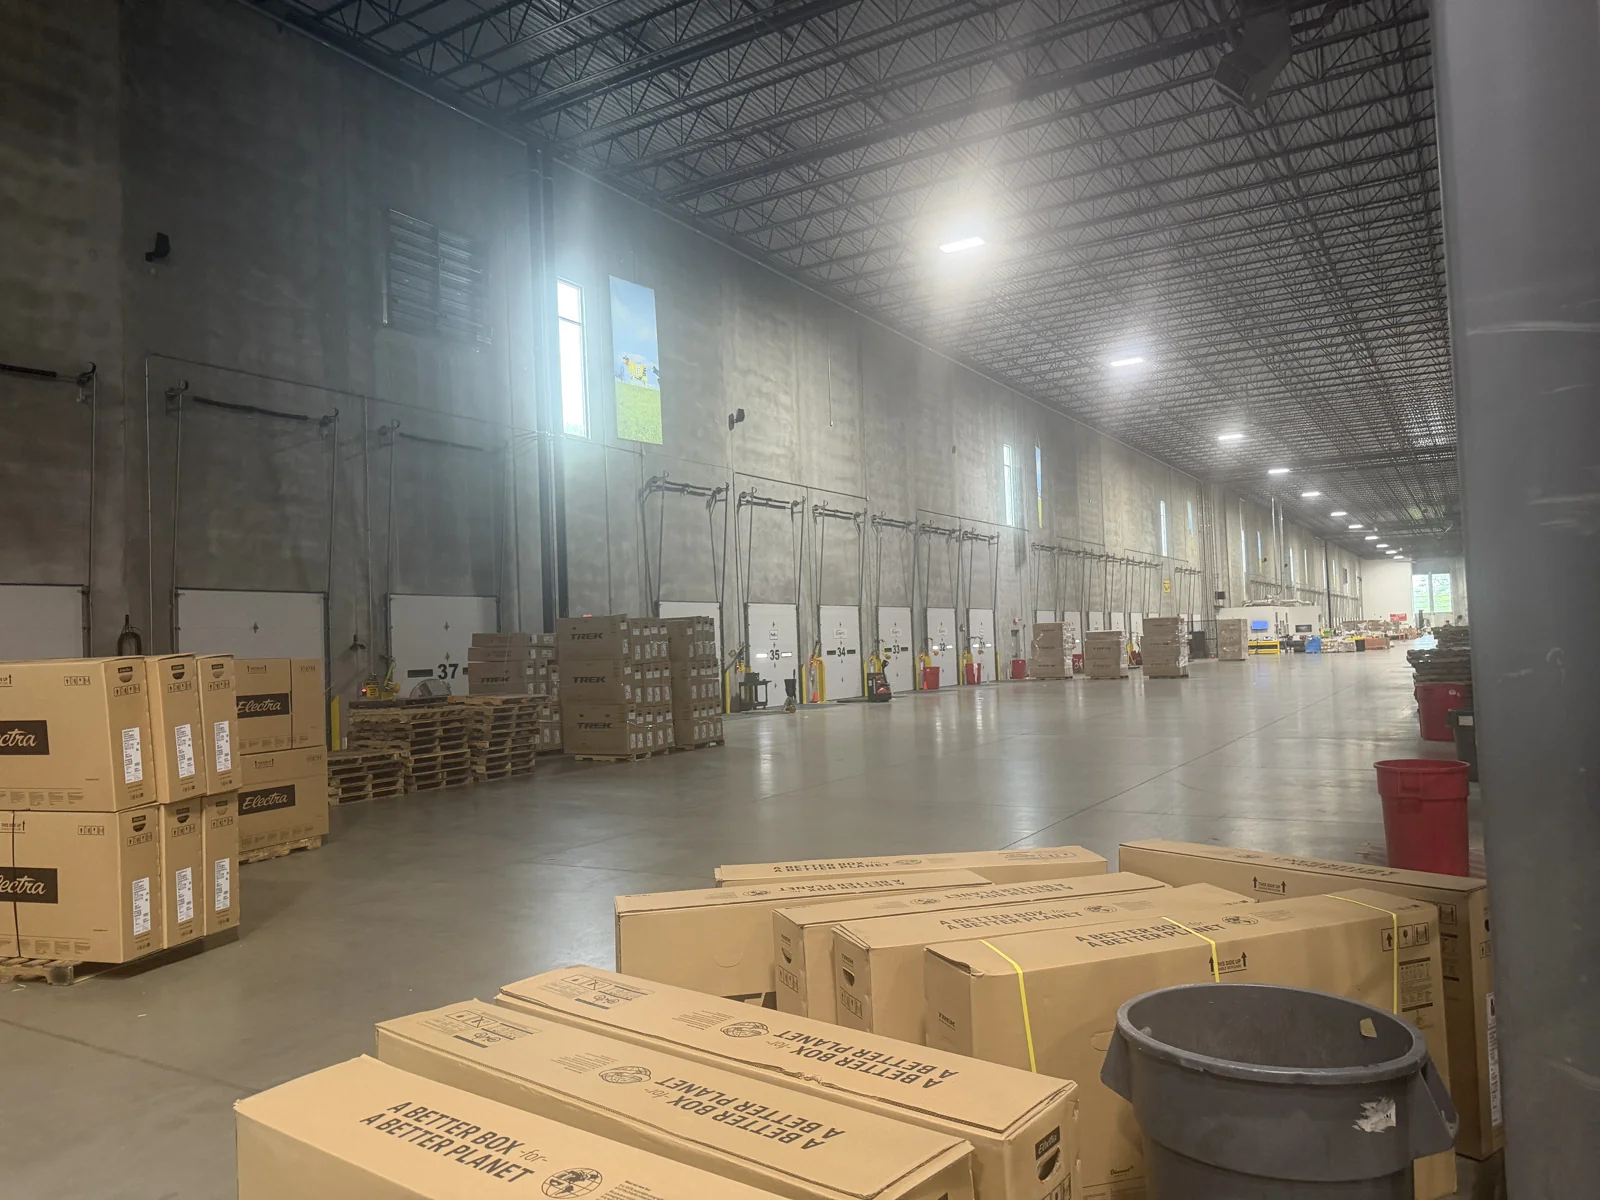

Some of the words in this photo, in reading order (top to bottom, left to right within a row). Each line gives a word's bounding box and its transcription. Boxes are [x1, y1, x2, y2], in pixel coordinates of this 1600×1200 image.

[570, 632, 604, 640] TREK
[769, 650, 780, 661] 35
[837, 647, 846, 657] 34
[892, 644, 900, 654] 33
[437, 663, 459, 680] 37
[572, 676, 606, 684] TREK
[237, 698, 281, 714] Electra
[576, 722, 613, 730] TREK
[0, 728, 39, 747] ctra
[242, 792, 288, 810] Electra
[952, 914, 1013, 924] BETTER
[1014, 910, 1047, 918] BOX
[960, 918, 1022, 929] BETTER
[1023, 911, 1083, 923] PLANET
[1088, 927, 1152, 940] BETTER
[1100, 933, 1166, 946] BETTER
[938, 1011, 956, 1027] TREK
[773, 1030, 855, 1053] PLANET
[788, 1045, 839, 1063] BOX
[851, 1048, 938, 1075] BETTER
[834, 1056, 921, 1085] BETTER
[939, 1069, 960, 1079] A
[654, 1077, 739, 1106] PLANET
[922, 1078, 944, 1089] A
[666, 1095, 718, 1116] BOX
[733, 1100, 824, 1134] BETTER
[387, 1101, 413, 1113] A
[402, 1106, 482, 1139] BETTER
[470, 1131, 525, 1155] BOX
[711, 1110, 803, 1145] BETTER
[821, 1127, 846, 1139] A
[359, 1113, 386, 1126] A
[375, 1118, 455, 1153] BETTER
[444, 1144, 535, 1183] PLANET
[800, 1138, 826, 1150] A
